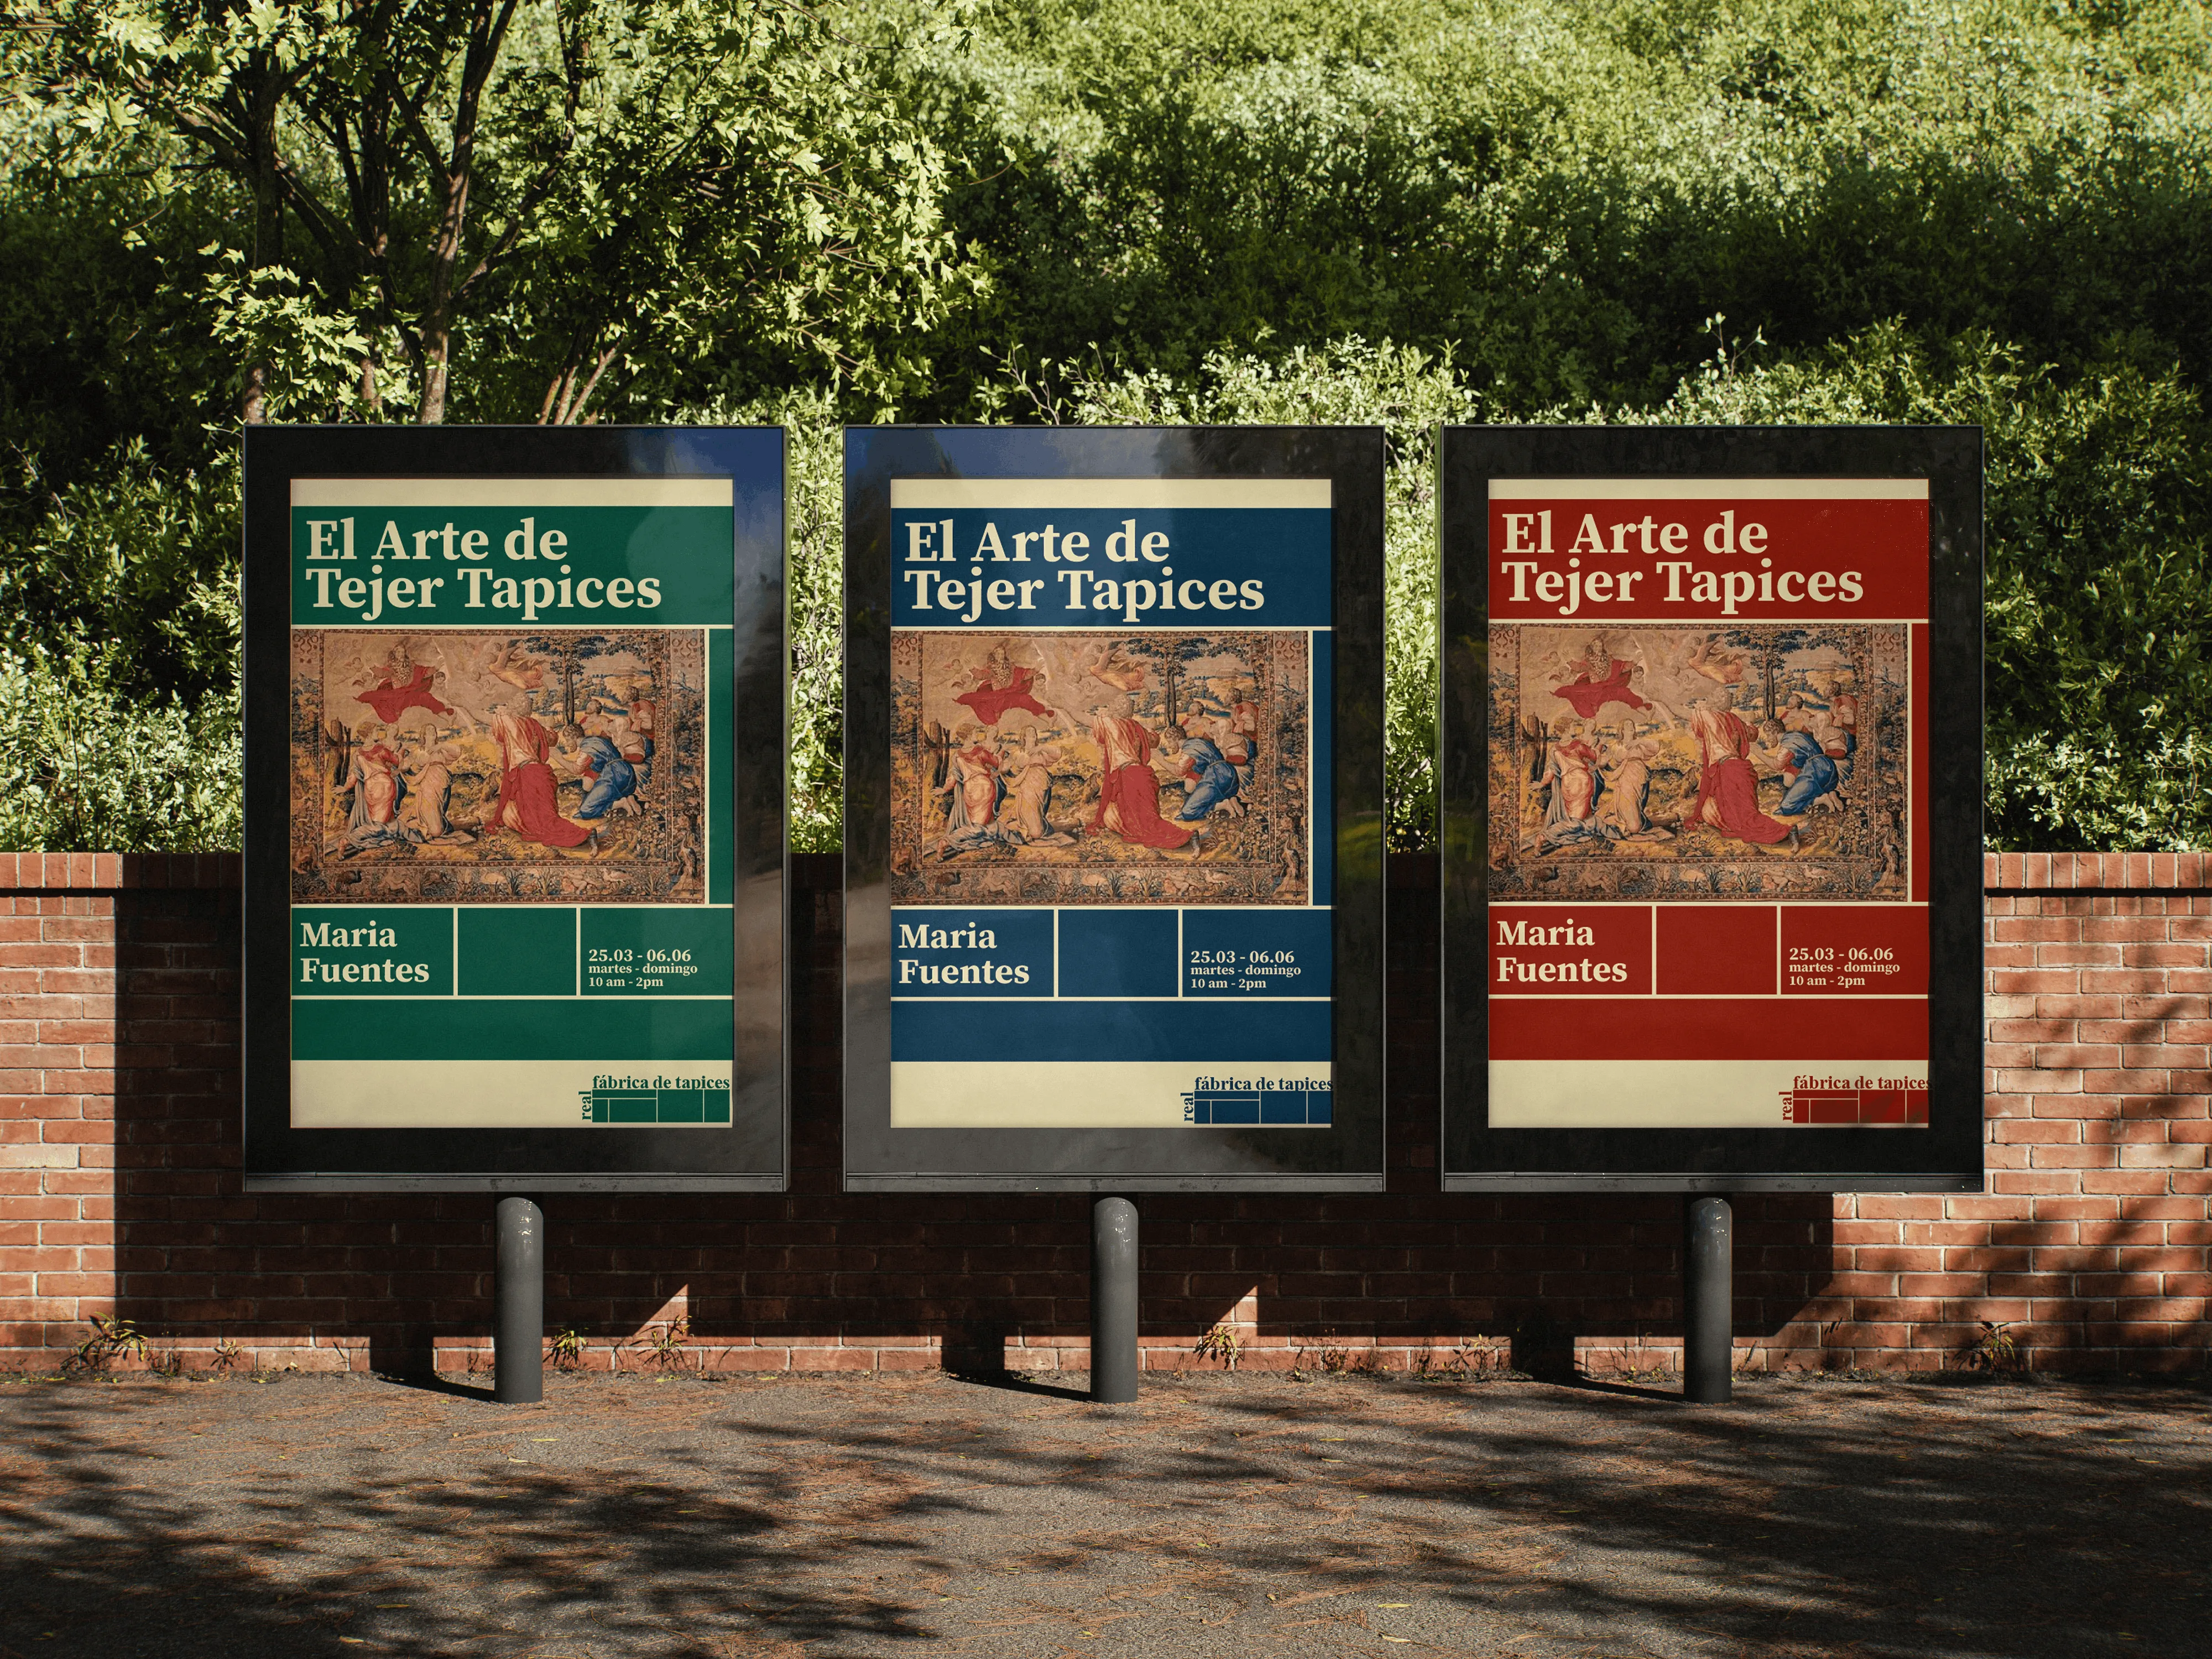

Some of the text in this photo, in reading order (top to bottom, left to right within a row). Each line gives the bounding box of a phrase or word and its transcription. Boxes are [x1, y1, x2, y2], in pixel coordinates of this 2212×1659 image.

[307, 517, 567, 560] El Arte de
[905, 519, 1170, 562] El Arte de
[1503, 510, 1768, 554] El Arte de
[306, 565, 661, 621] Tejer Tapices
[905, 567, 1264, 623] Tejer Tapices
[1502, 558, 1864, 615] Tejer Tapices
[300, 920, 397, 947] Maria
[899, 922, 997, 948] Maria
[1496, 919, 1595, 946] Maria
[589, 950, 633, 962] 25.03
[647, 950, 691, 962] 06.06
[1191, 951, 1235, 963] 25.03
[1250, 951, 1295, 963] 06.06
[1790, 948, 1834, 961] 25.03
[1849, 948, 1893, 961] 06.06
[301, 958, 430, 983] Fuentes
[589, 964, 632, 974] martes
[643, 963, 698, 977] domingo
[899, 960, 1030, 984] Fuentes
[1191, 966, 1235, 975] martes
[1245, 964, 1301, 978] domingo
[1497, 958, 1627, 982] Fuentes
[1790, 963, 1834, 972] martes
[1844, 962, 1900, 975] domingo
[589, 977, 603, 987] 10
[637, 977, 664, 989] 2pm
[1191, 979, 1206, 988] 10
[1239, 979, 1266, 991] 2pm
[1790, 976, 1804, 985] 10
[1838, 976, 1866, 989] 2pm
[592, 1075, 730, 1090] fábrica de tapices
[1195, 1076, 1333, 1091] fábrica de tapices
[1793, 1075, 1850, 1089] fábrica
[1855, 1076, 1874, 1089] de
[578, 1091, 592, 1120] real
[1181, 1092, 1194, 1121] real
[1779, 1091, 1792, 1121] real
